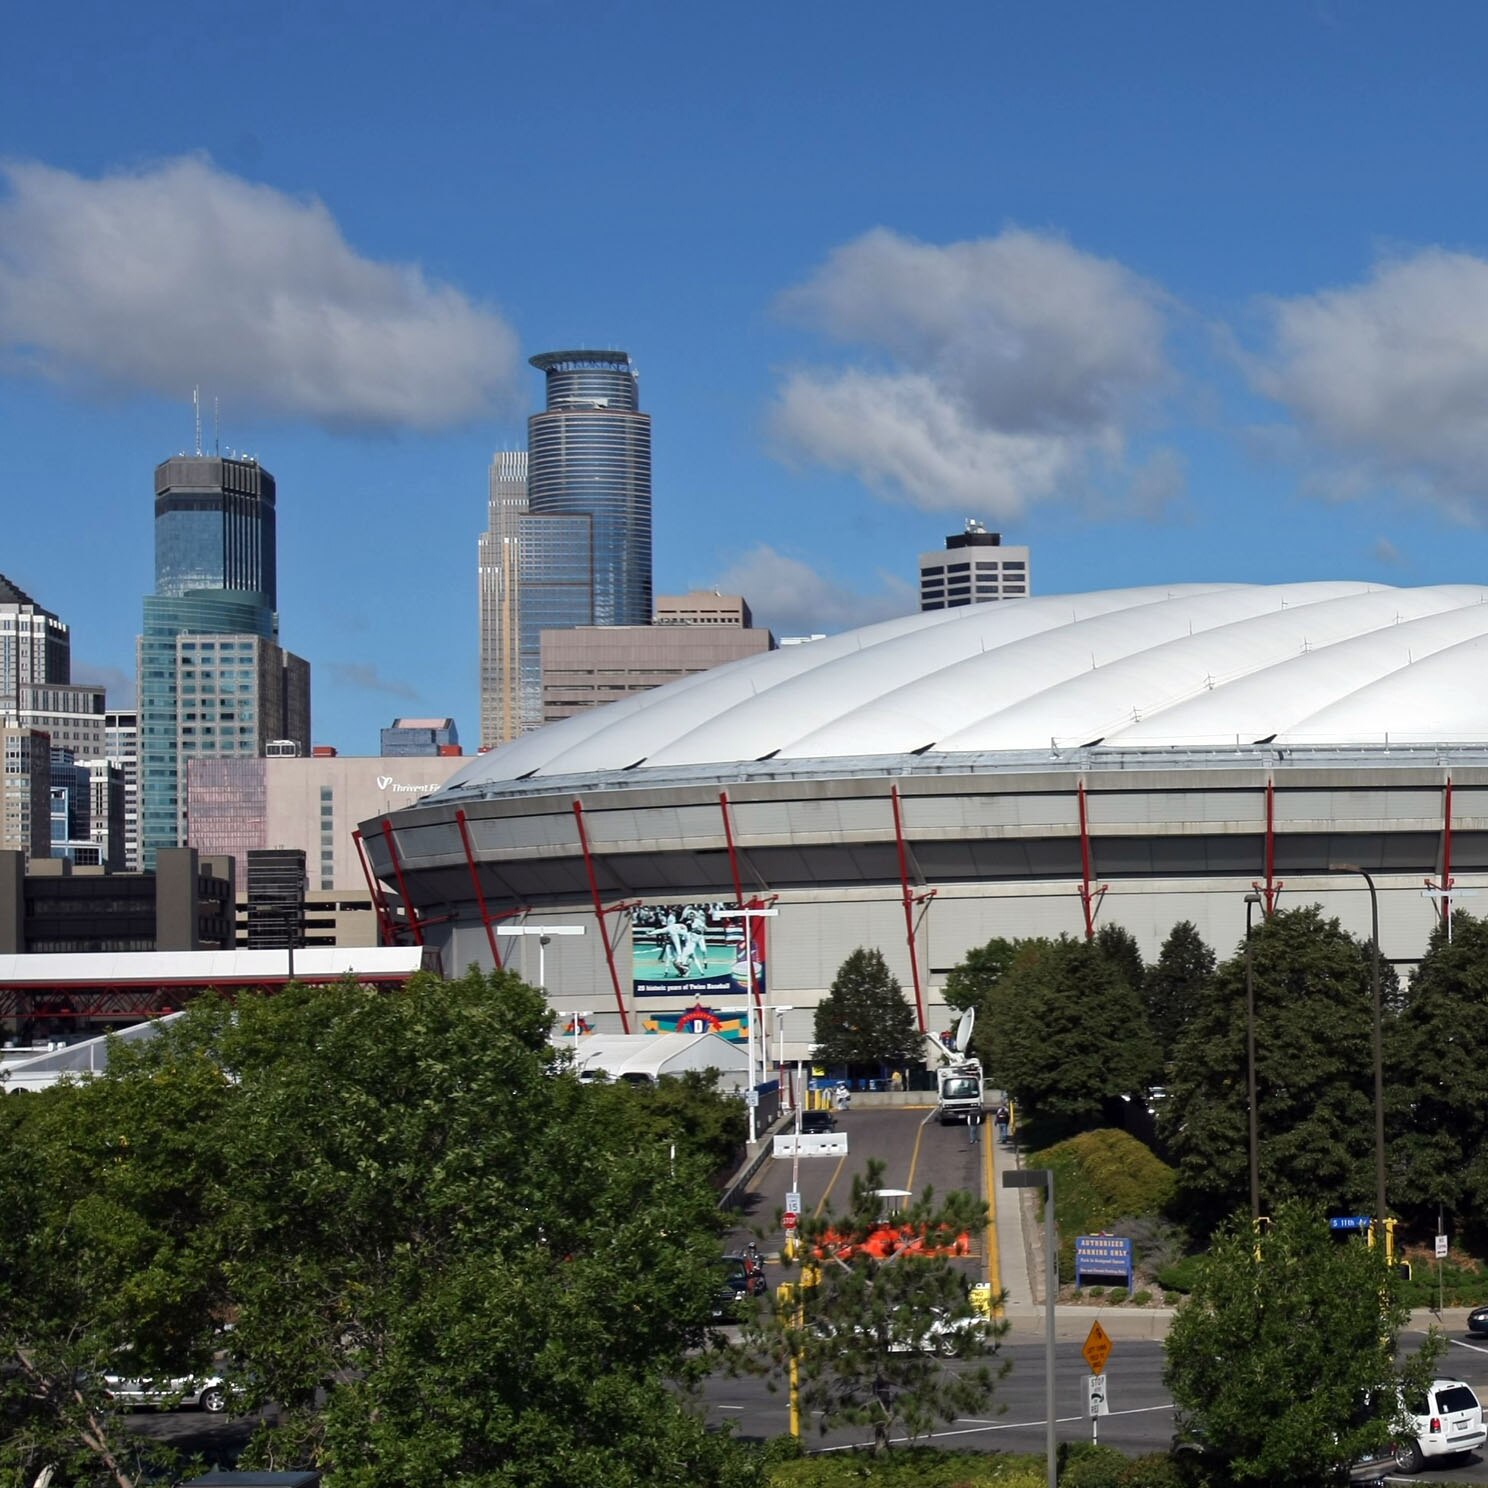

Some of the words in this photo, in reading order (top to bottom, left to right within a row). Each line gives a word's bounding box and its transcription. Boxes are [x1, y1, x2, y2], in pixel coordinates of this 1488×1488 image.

[1333, 1219, 1338, 1227] S
[1081, 1239, 1124, 1248] AUTHORIZED
[1078, 1248, 1108, 1256] PARKING
[1110, 1249, 1127, 1257] ONLY
